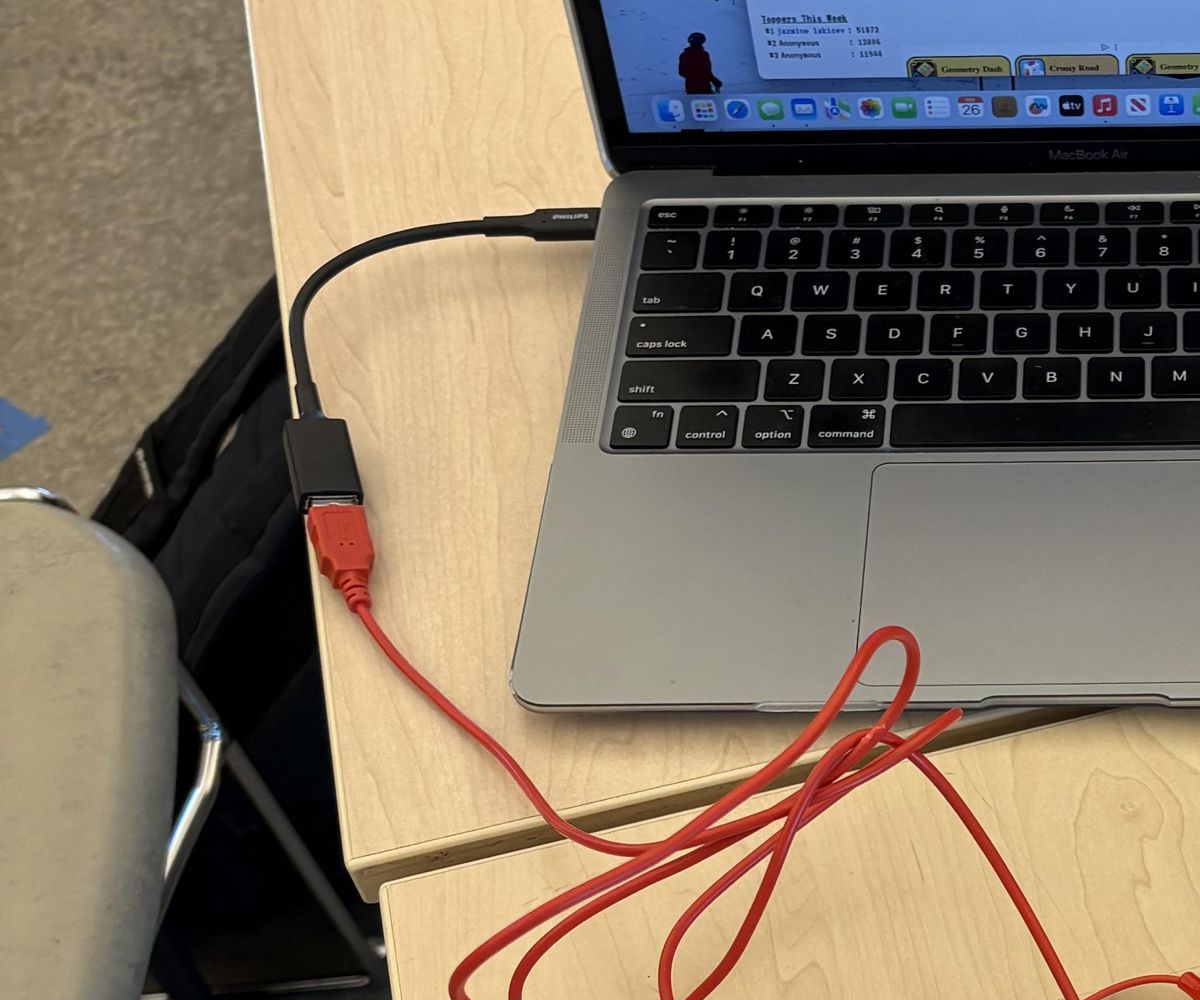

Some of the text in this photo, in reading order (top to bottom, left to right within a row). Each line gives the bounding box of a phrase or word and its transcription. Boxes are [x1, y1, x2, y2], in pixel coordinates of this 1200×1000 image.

[801, 15, 822, 24] This
[941, 65, 1003, 75] Geometry Dash
[1078, 64, 1100, 72] Road
[1159, 62, 1199, 72] Geometry
[962, 104, 981, 116] 26
[1048, 149, 1128, 161] MacBook Air
[552, 212, 590, 220] PHILIPS
[789, 237, 801, 246] @
[852, 237, 861, 245] #
[727, 249, 735, 260] 1
[788, 249, 799, 260] 2
[850, 248, 861, 260] 3
[911, 248, 922, 259] 4
[973, 248, 985, 259] 5
[1035, 247, 1046, 258] 6
[1097, 246, 1108, 257] 7
[1158, 246, 1170, 257] 8
[750, 285, 764, 297] Q
[812, 284, 830, 296] W
[877, 284, 888, 296] E
[940, 284, 952, 295] R
[1002, 283, 1014, 295] T
[1065, 283, 1077, 294] Y
[1127, 282, 1140, 294] U
[1193, 281, 1198, 293] I
[642, 296, 661, 304] tab
[761, 328, 774, 340] A
[825, 328, 837, 340] S
[888, 328, 901, 339] D
[953, 327, 964, 338] F
[1015, 327, 1028, 338] G
[1079, 326, 1092, 338] H
[1143, 325, 1153, 337] J
[636, 340, 687, 349] caps lock
[788, 373, 800, 385] Z
[852, 373, 865, 385] X
[917, 372, 930, 385] C
[981, 372, 994, 384] V
[1046, 371, 1058, 383] B
[1110, 371, 1123, 382] N
[1172, 370, 1187, 382] M
[628, 385, 655, 394] shift
[652, 410, 664, 418] fn
[685, 430, 726, 439] control
[754, 430, 792, 440] option
[818, 429, 875, 439] command
